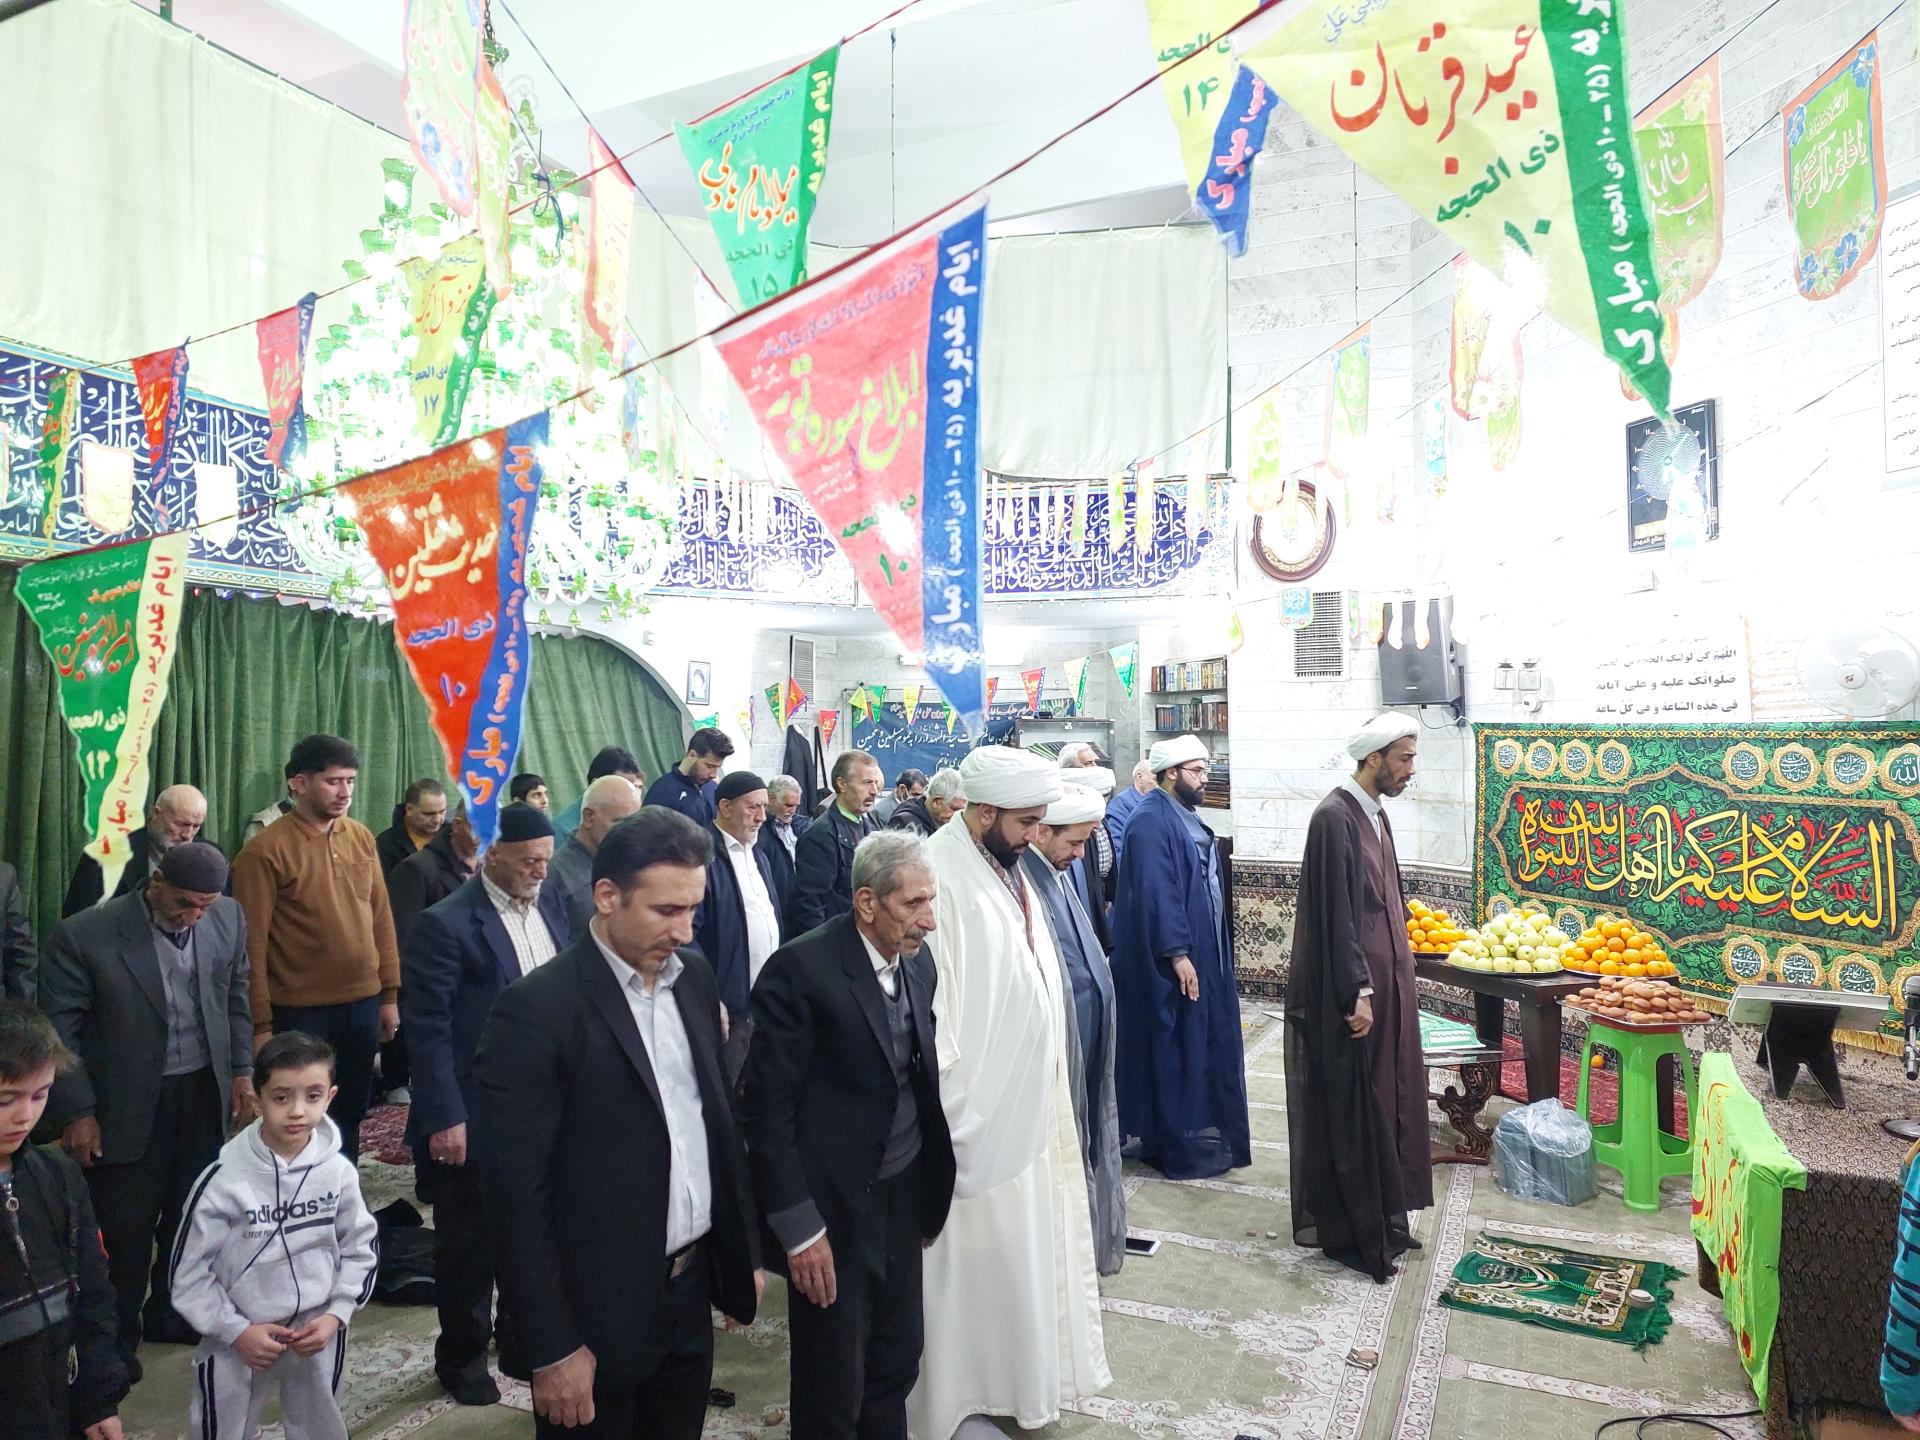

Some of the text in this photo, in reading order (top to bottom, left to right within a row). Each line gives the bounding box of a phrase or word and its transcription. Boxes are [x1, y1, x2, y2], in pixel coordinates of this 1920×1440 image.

[1183, 77, 1219, 118] ۱۴
[1330, 22, 1539, 175] عید قربان
[1436, 129, 1561, 223] ذی الحجه
[726, 236, 793, 263] ذی الحجه
[943, 240, 979, 296] ایام
[751, 272, 778, 298] ۱۵
[1607, 260, 1659, 366] مبارک
[423, 393, 439, 416] ۱۷
[859, 349, 920, 471] ابلاغ
[807, 399, 861, 457] سوره
[505, 444, 539, 492] ایام
[389, 492, 498, 601] حدیث ثقلین
[151, 555, 178, 597] ایام
[880, 553, 908, 587] ۱۰
[147, 602, 166, 676] غدیریه
[405, 611, 496, 647] ذی الحجه
[438, 672, 467, 707] ۱۰
[1624, 680, 1647, 691] علی
[1651, 682, 1657, 690] و
[1661, 678, 1684, 690] علیه
[104, 705, 126, 732] ذی
[1636, 703, 1650, 715] فی
[1722, 700, 1738, 715] فی
[465, 726, 509, 805] مبارک
[1584, 803, 1667, 892] اهل
[1642, 804, 1686, 878] یا
[1650, 809, 1785, 906] علیکم
[1716, 815, 1897, 936] السلام
[245, 1200, 318, 1225] adidas
